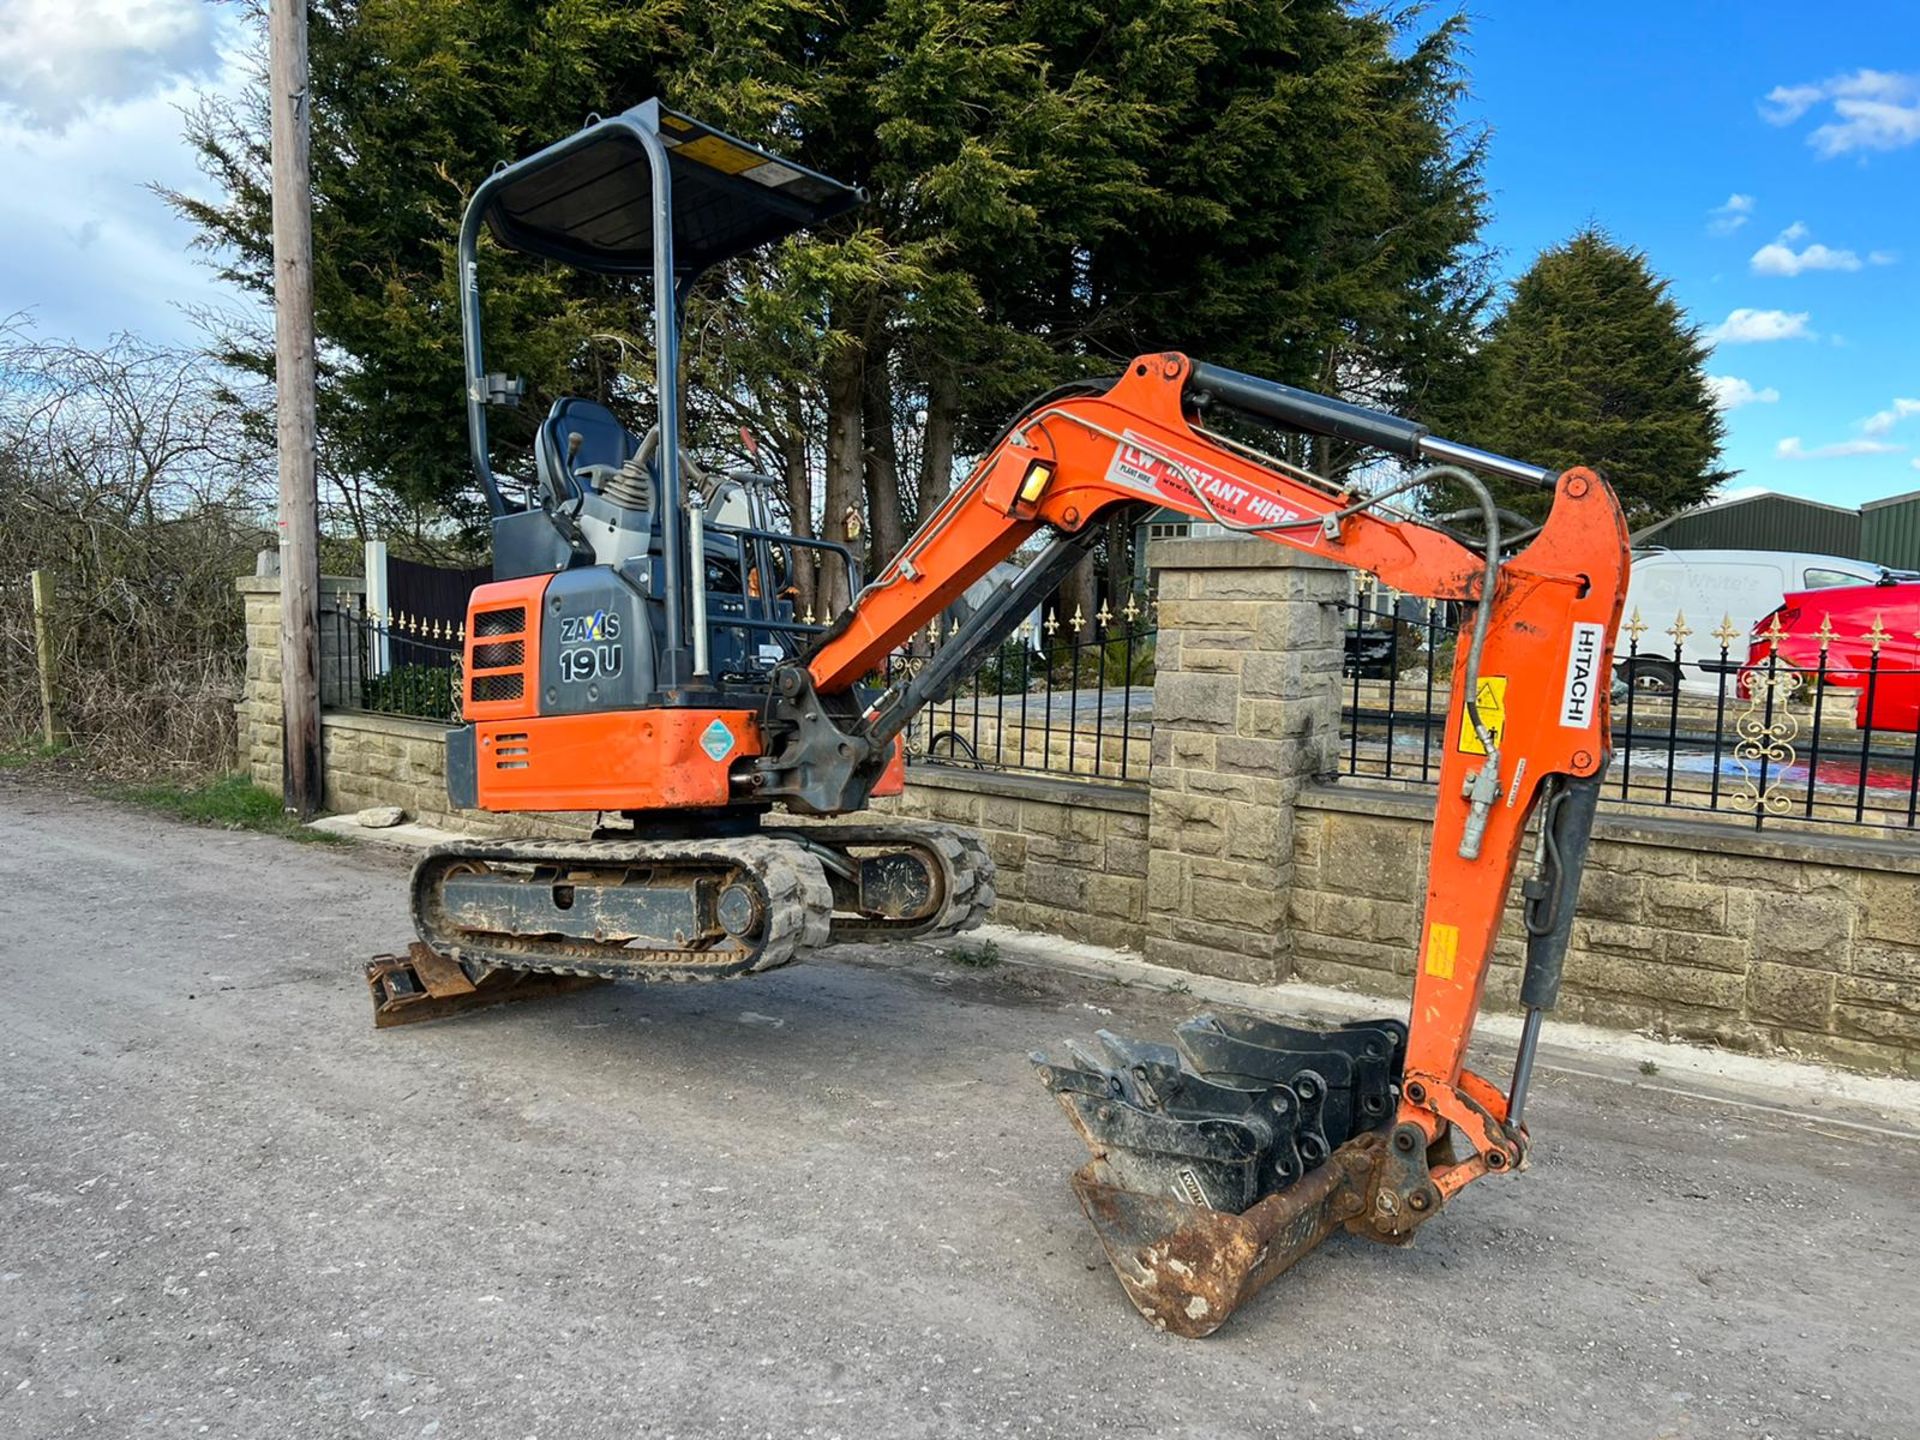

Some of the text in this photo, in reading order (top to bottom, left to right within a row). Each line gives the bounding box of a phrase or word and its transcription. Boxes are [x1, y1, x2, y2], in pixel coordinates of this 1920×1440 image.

[1166, 462, 1249, 505] INSTANT
[561, 609, 621, 643] ZAXIS
[560, 645, 623, 683] 19U
[1567, 630, 1595, 722] HITACHI
